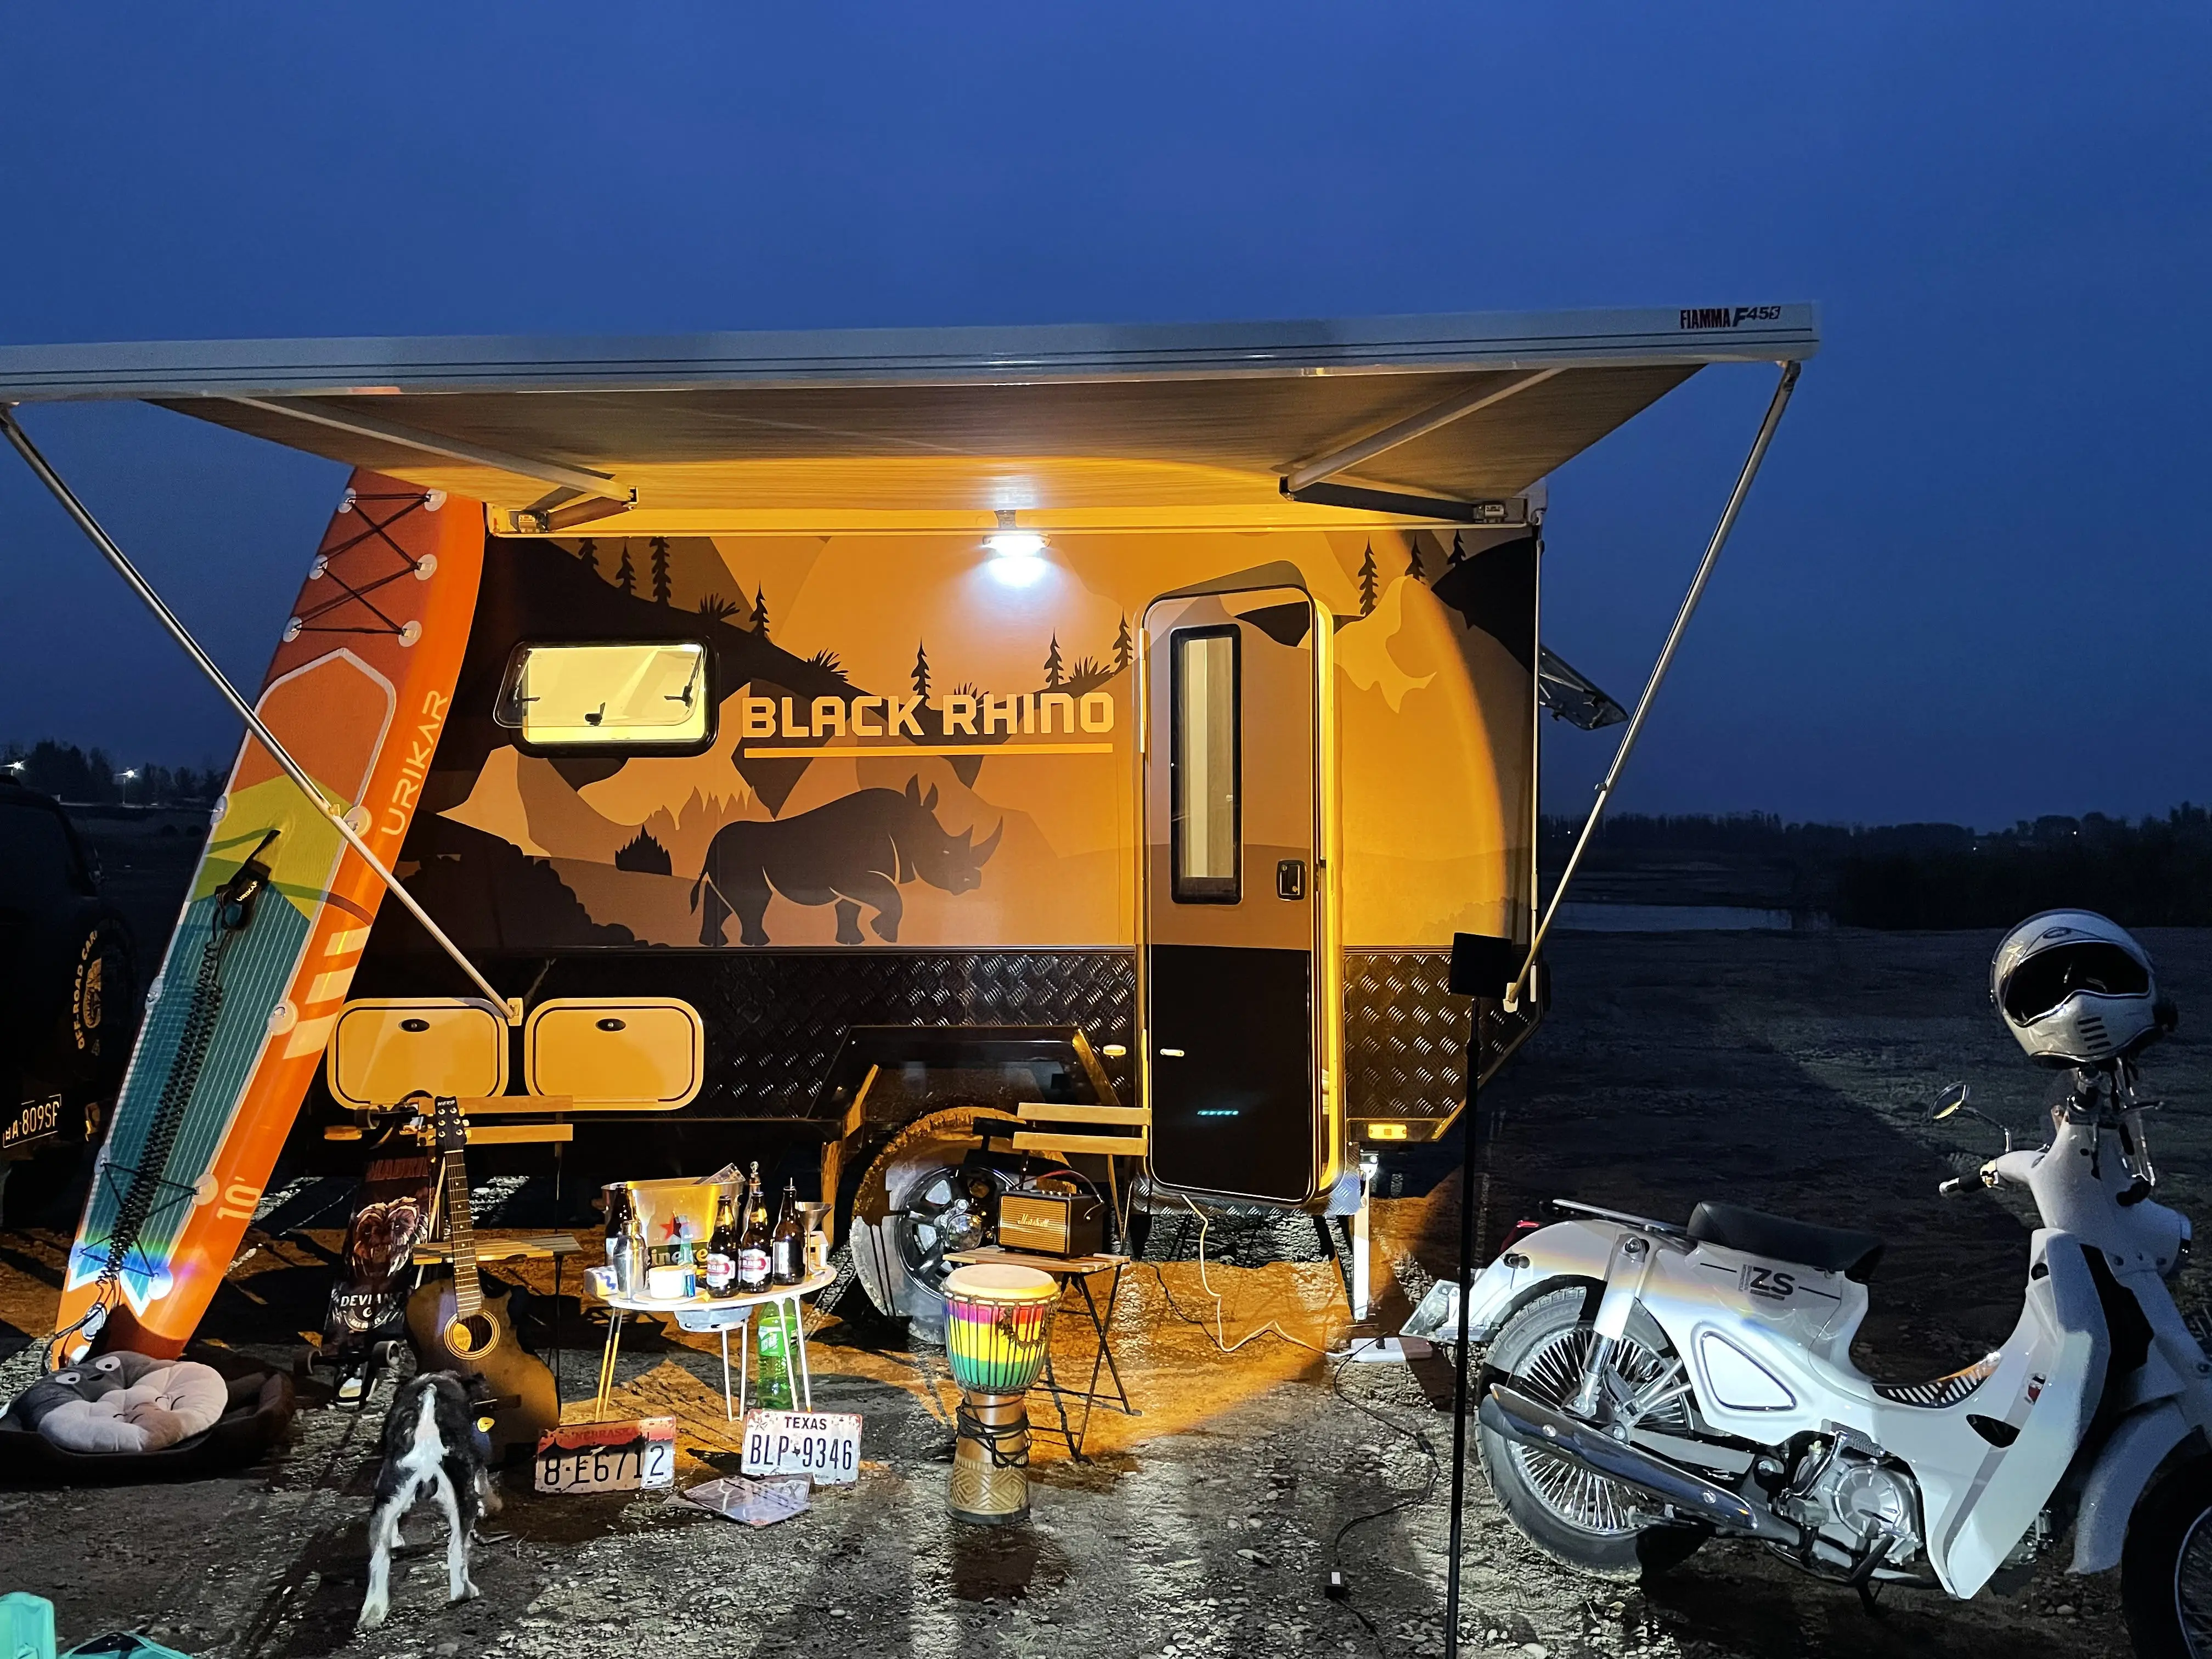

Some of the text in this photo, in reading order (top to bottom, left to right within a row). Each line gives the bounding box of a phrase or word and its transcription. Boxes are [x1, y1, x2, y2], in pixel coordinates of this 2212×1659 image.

[1680, 308, 1730, 329] FIAMMA
[742, 692, 1114, 738] BLACK RHINO
[381, 690, 448, 836] URIKAR
[72, 964, 84, 1049] OFF-ROAD
[1750, 1266, 1796, 1295] ZS
[785, 1417, 827, 1430] TEXAS
